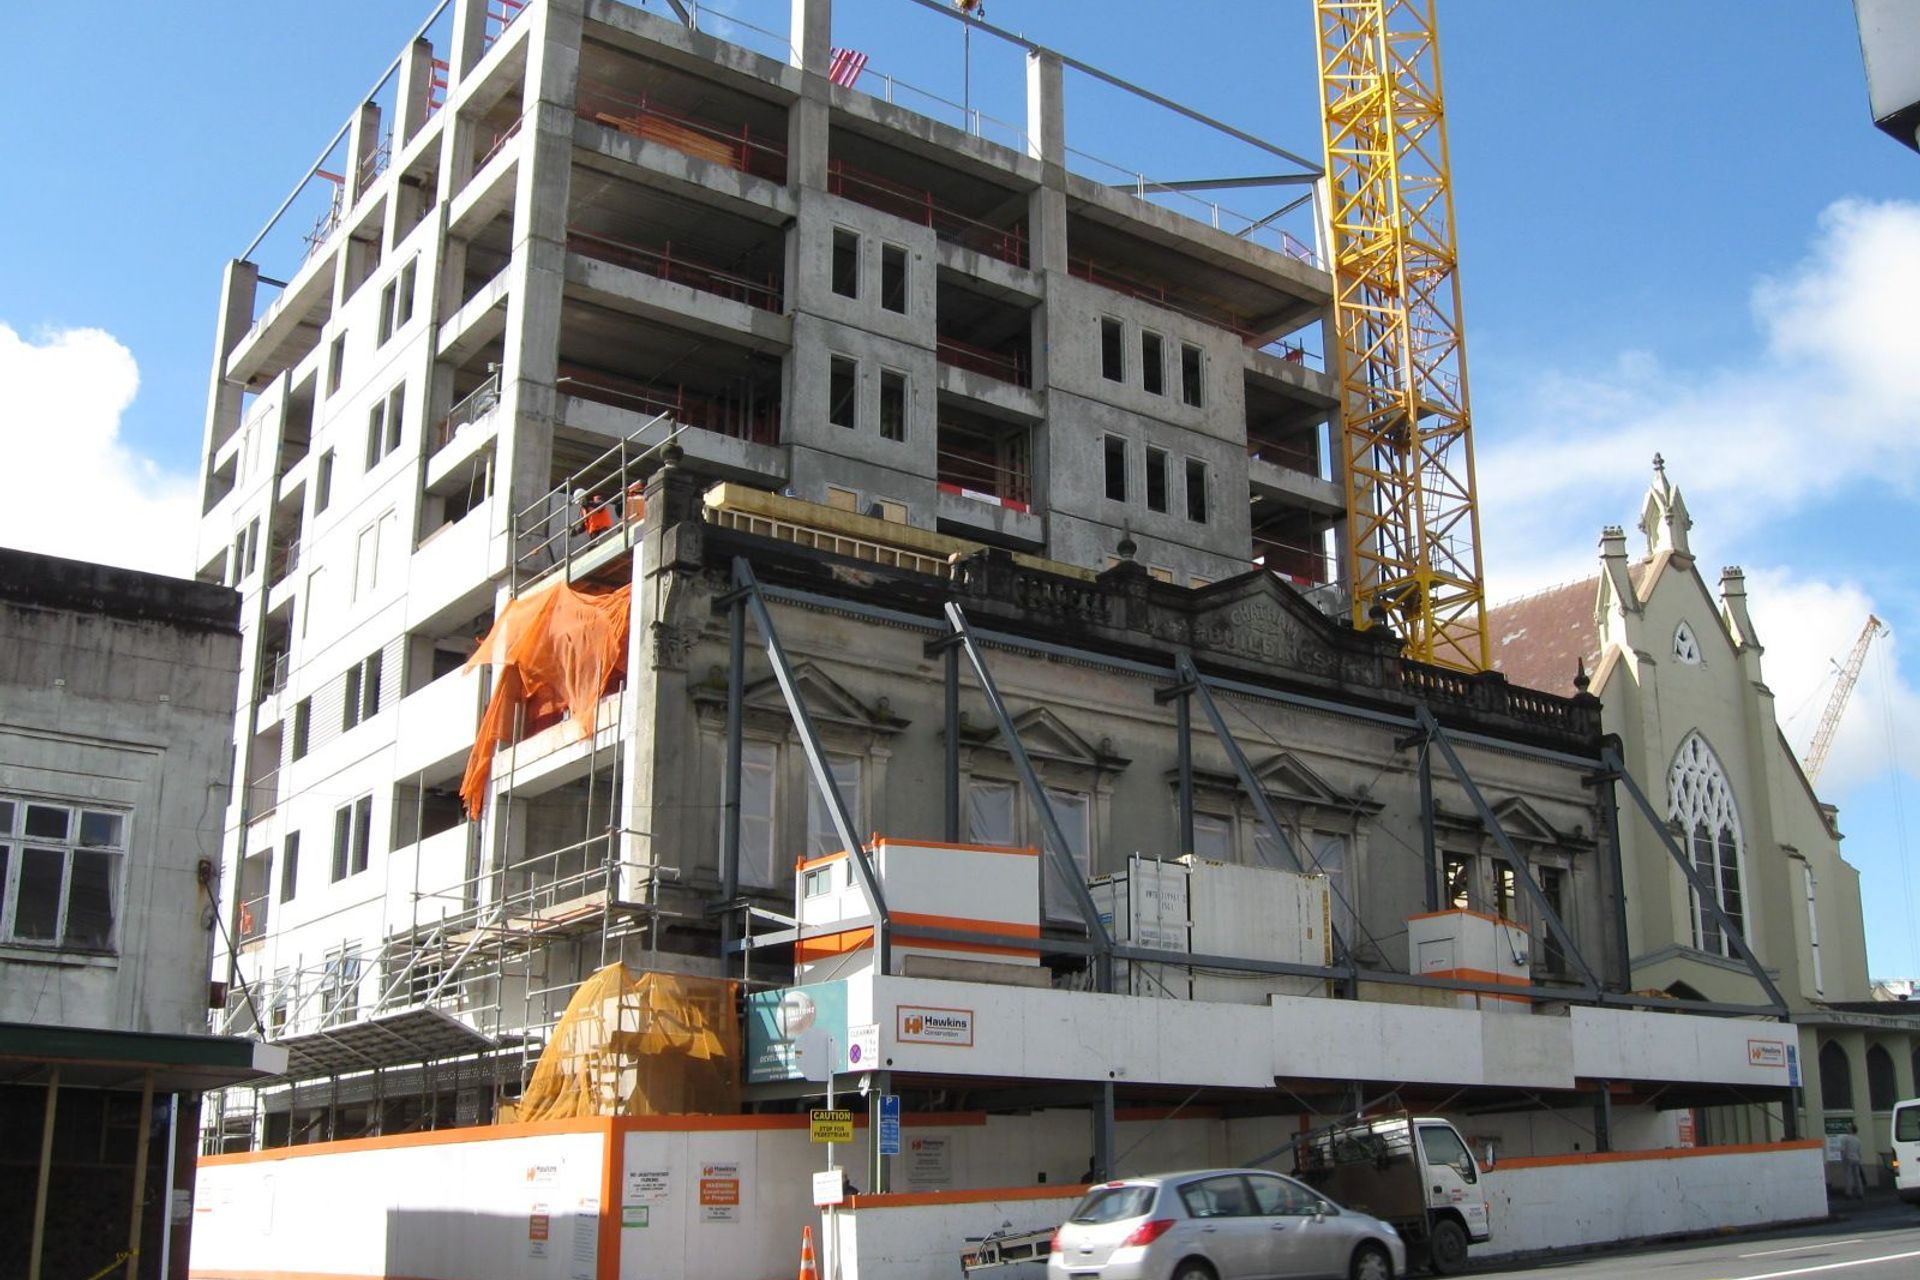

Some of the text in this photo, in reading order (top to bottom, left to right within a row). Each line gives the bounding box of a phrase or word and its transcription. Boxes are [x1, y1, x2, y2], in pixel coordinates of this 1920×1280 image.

[1208, 628, 1327, 667] BUILDINGS
[924, 1015, 967, 1028] Hawkins
[924, 1029, 959, 1038] Construction
[813, 1111, 851, 1120] CAUTION
